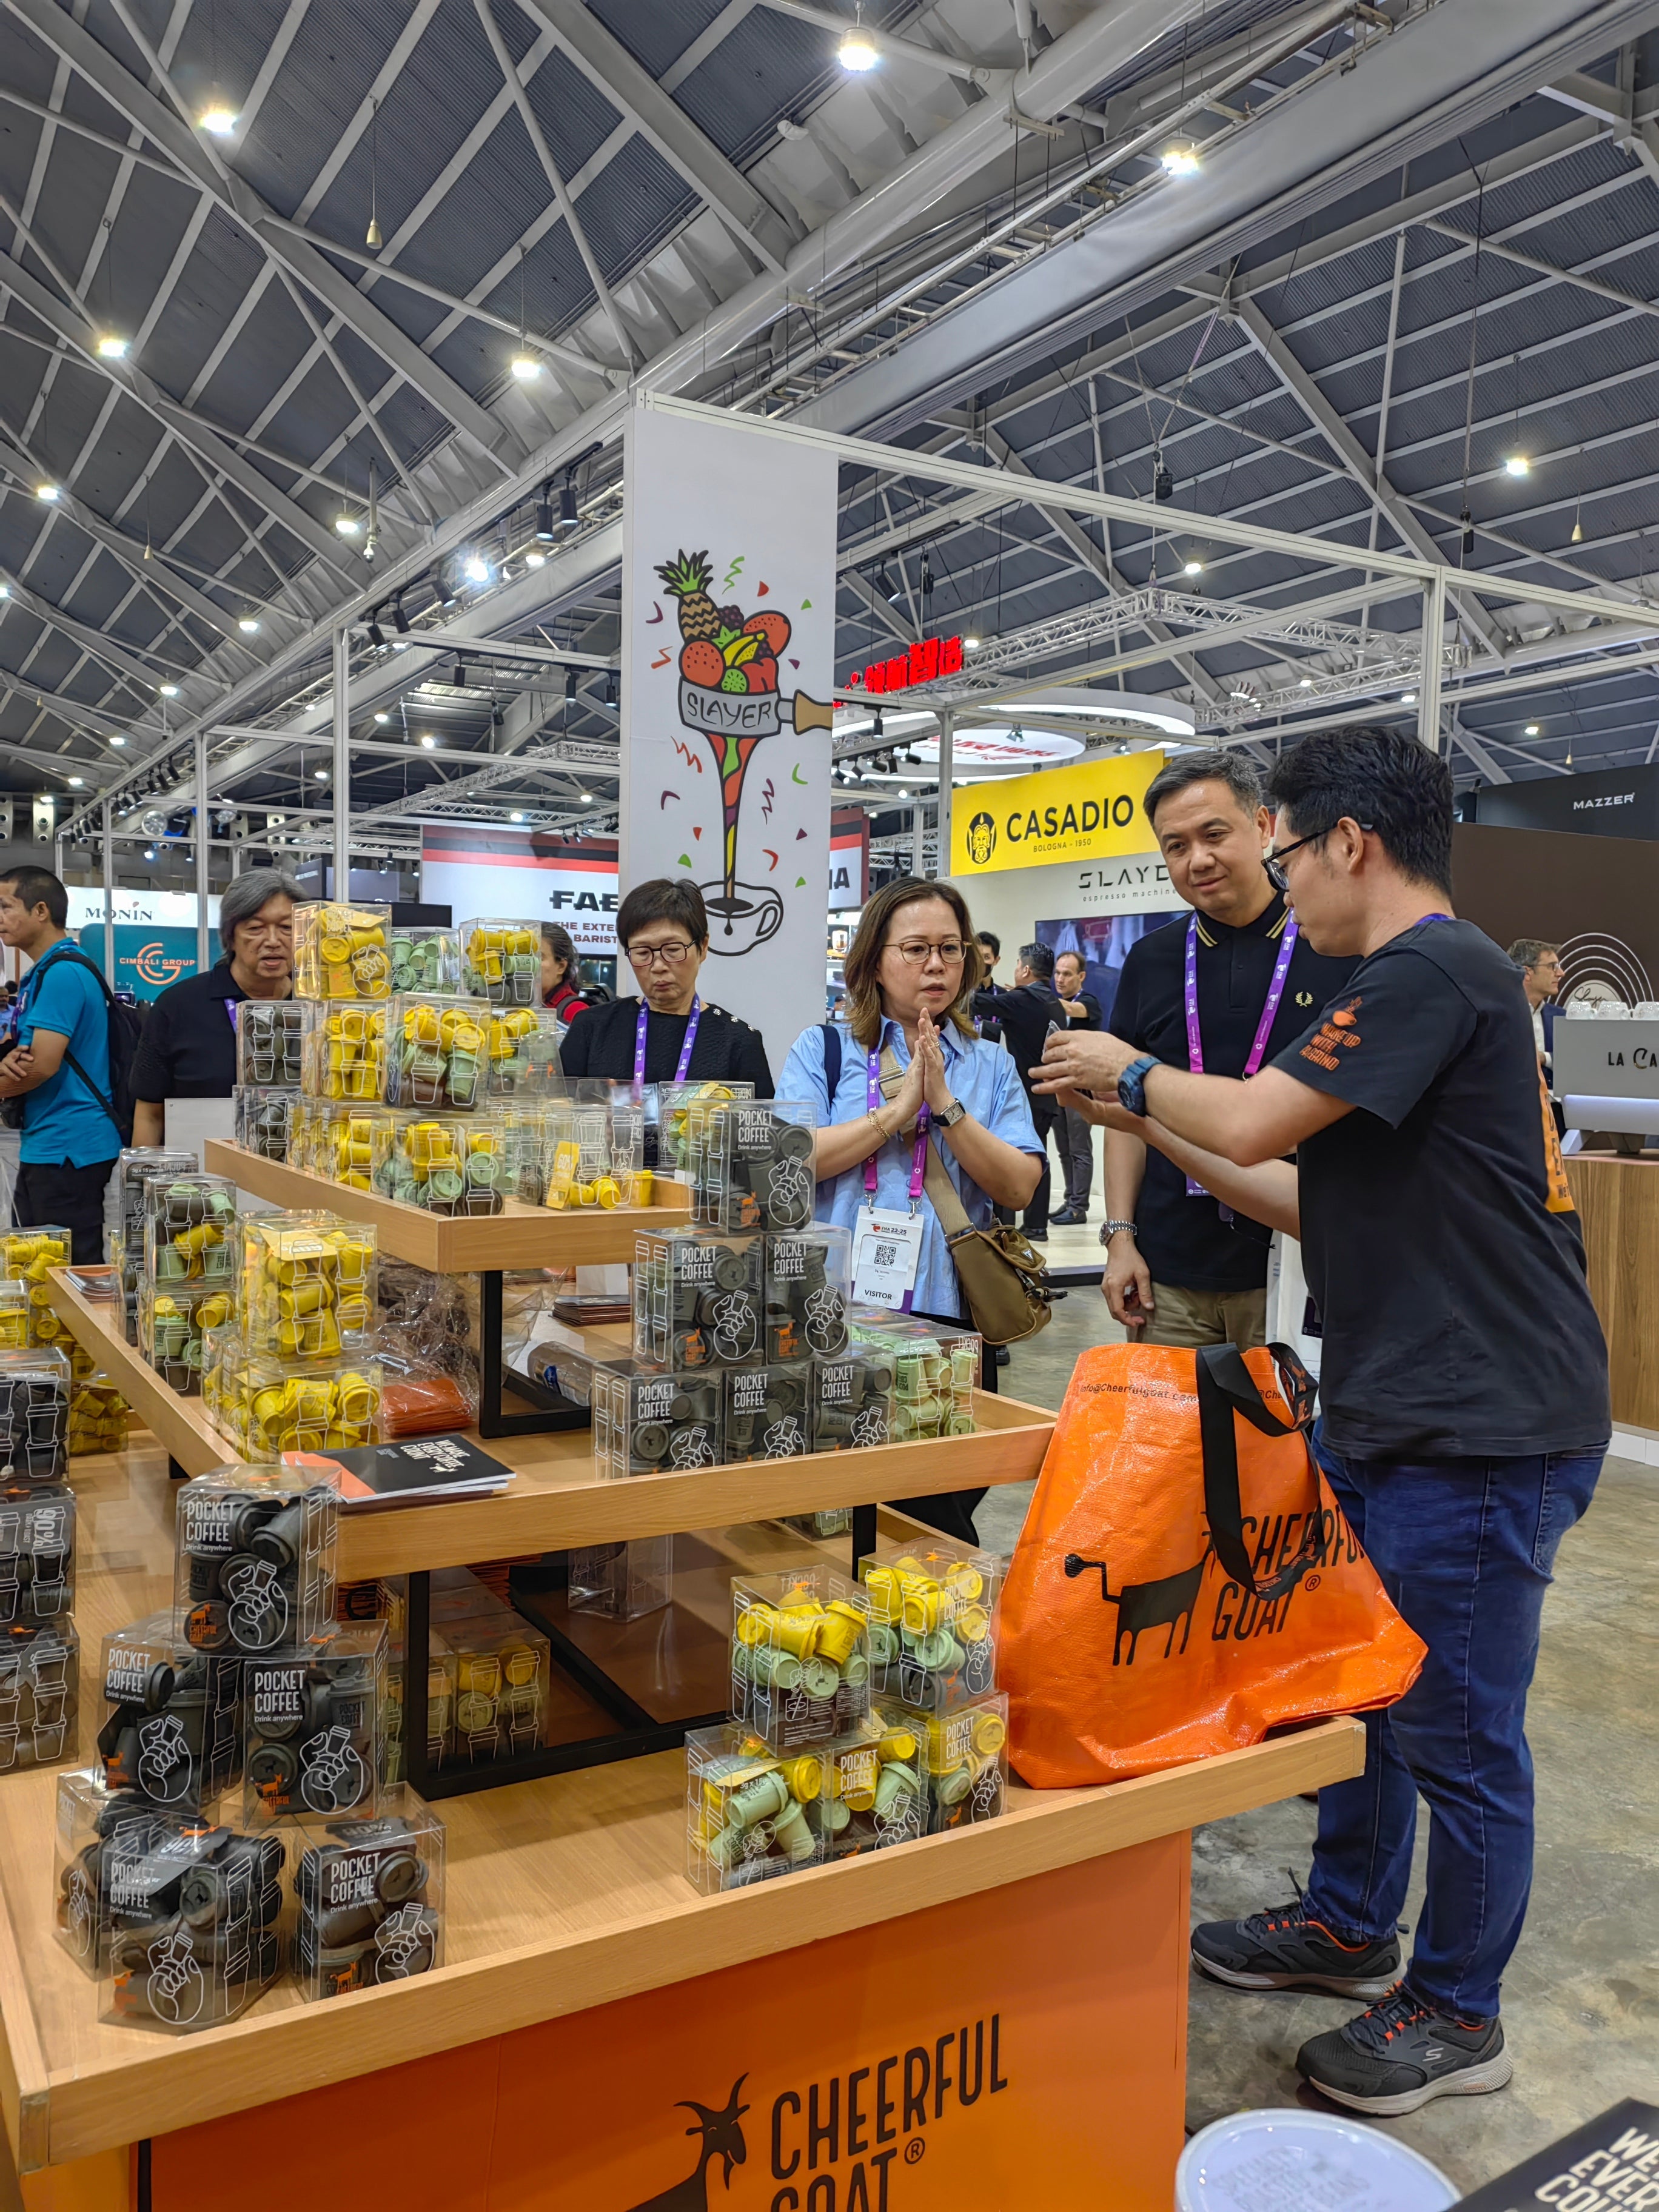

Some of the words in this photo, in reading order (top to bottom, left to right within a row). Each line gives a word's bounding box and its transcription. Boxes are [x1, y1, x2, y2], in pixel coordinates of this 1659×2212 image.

[687, 692, 771, 728] SLAYER
[1573, 792, 1635, 810] MAZZER
[1007, 795, 1133, 842] CASADIO
[1033, 842, 1067, 853] BOLOGNA
[1075, 838, 1091, 847] 1950
[1083, 893, 1126, 902] espresso
[1608, 1051, 1624, 1066] LA
[739, 1110, 773, 1126] POCKET
[738, 1127, 769, 1142] COFFEE
[682, 1246, 717, 1264] POCKET
[774, 1242, 807, 1259] POCKET
[682, 1263, 714, 1279] COFFEE
[774, 1258, 805, 1275] COFFEE
[864, 1289, 893, 1300] VISITOR
[734, 1373, 768, 1392] POCKET
[822, 1365, 854, 1383] POCKET
[638, 1383, 675, 1402] POCKET
[734, 1390, 765, 1408] COFFEE
[822, 1381, 851, 1399] COFFEE
[638, 1401, 671, 1419] COFFEE
[187, 1501, 236, 1521] POCKET
[33, 1509, 56, 1547] 90%
[186, 1522, 229, 1541] COFFEE
[109, 1649, 150, 1673] POCKET
[107, 1669, 144, 1693] COFFEE
[255, 1670, 305, 1692] POCKET
[255, 1692, 300, 1712] COFFEE
[272, 1714, 303, 1723] anywhere
[947, 1717, 974, 1743] POCKET
[946, 1736, 971, 1759] COFFEE
[840, 1749, 878, 1775] POCKET
[840, 1769, 873, 1792] COFFEE
[111, 1862, 155, 1885] POCKET
[332, 1852, 381, 1883] POCKET
[110, 1885, 150, 1909] COFFEE
[330, 1875, 375, 1904] COFFEE
[330, 1903, 347, 1914] Drink
[348, 1898, 378, 1911] anywhere
[771, 2013, 1008, 2180] CHEERFUL
